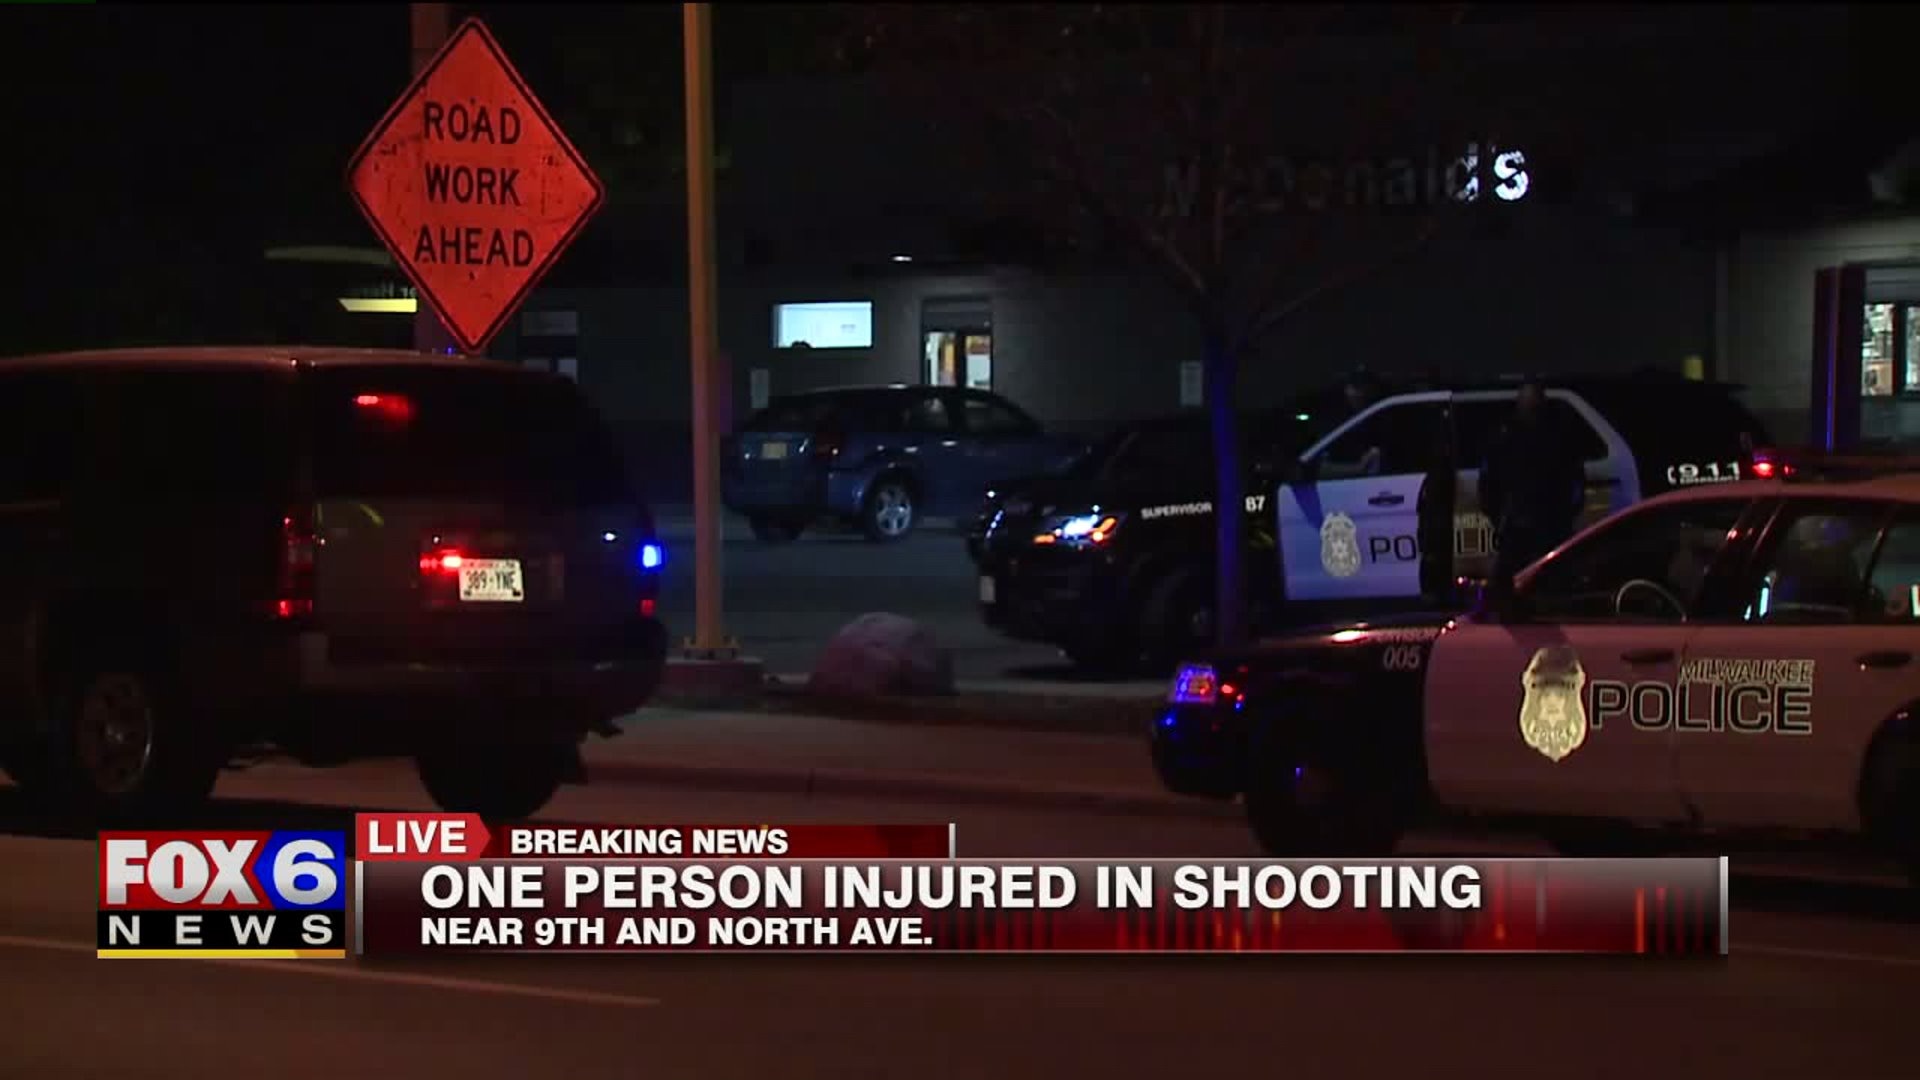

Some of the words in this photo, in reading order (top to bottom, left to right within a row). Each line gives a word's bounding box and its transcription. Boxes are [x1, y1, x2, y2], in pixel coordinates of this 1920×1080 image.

[423, 101, 521, 144] ROAD
[425, 162, 521, 206] WORK
[413, 224, 534, 267] AHEAD
[1140, 501, 1213, 519] SUPERVISOR
[1245, 495, 1265, 512] 87
[1383, 645, 1421, 670] 005
[1679, 659, 1815, 685] MILWAUKEE
[1589, 680, 1813, 734] POLICE
